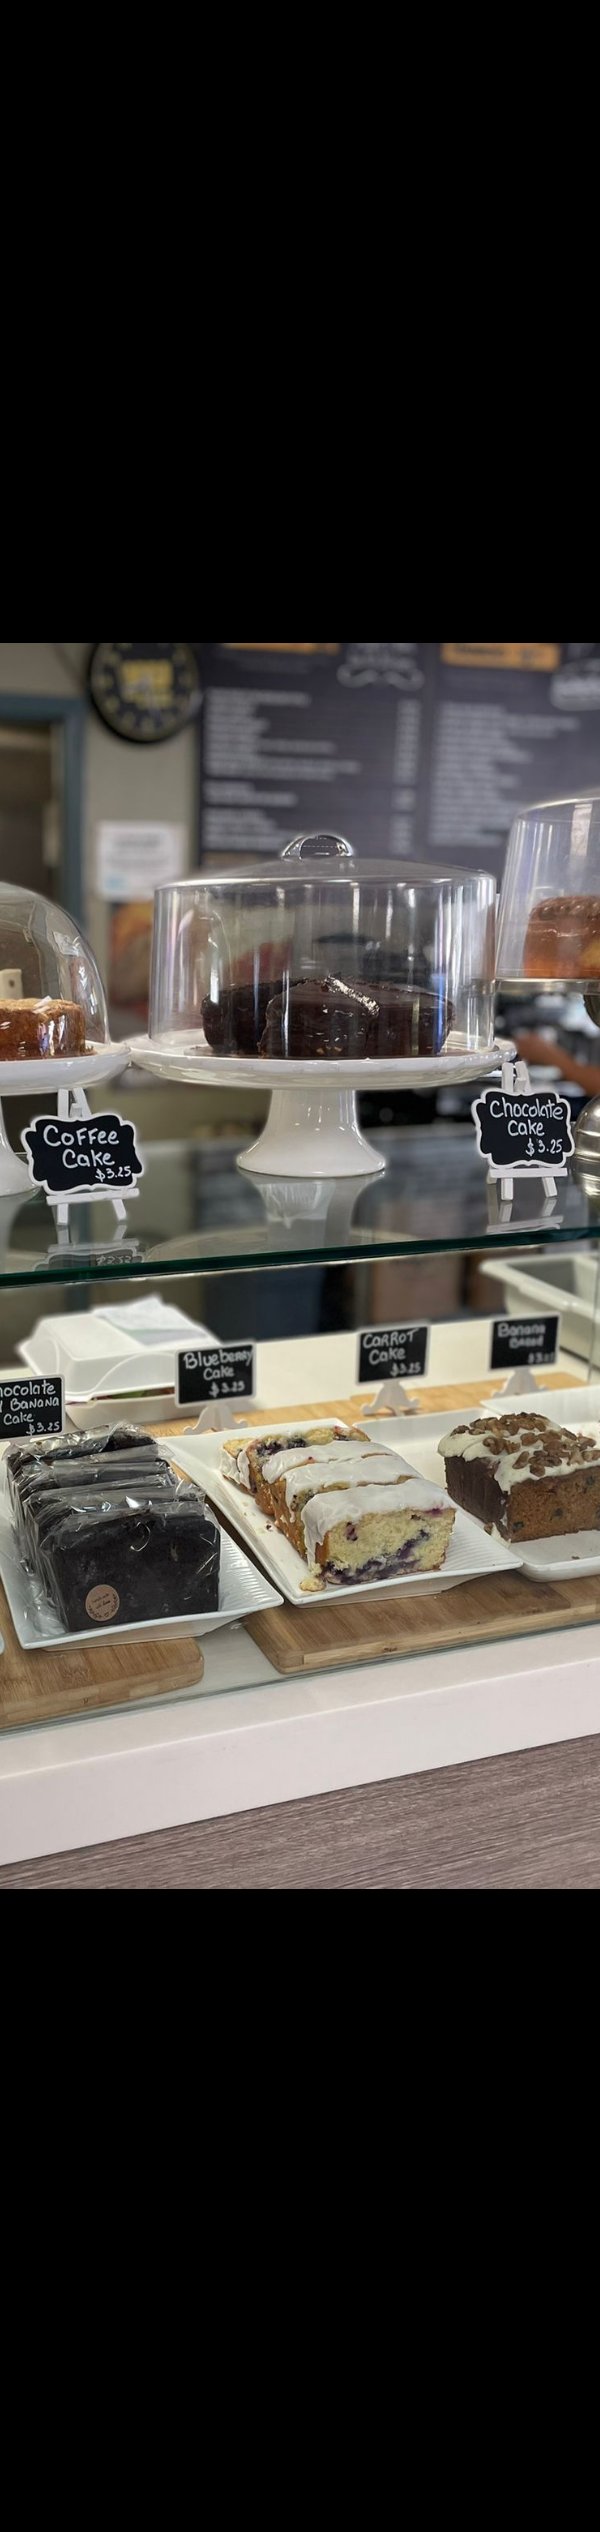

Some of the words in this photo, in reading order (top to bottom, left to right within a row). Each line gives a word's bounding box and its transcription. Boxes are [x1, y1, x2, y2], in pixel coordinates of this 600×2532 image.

[490, 1097, 564, 1120] Chocolate
[62, 1149, 115, 1169] Cake
[95, 1165, 131, 1182] $3.25
[203, 1365, 235, 1381] Cake
[3, 1411, 34, 1425] Cake
[26, 1421, 60, 1436] $3.25
